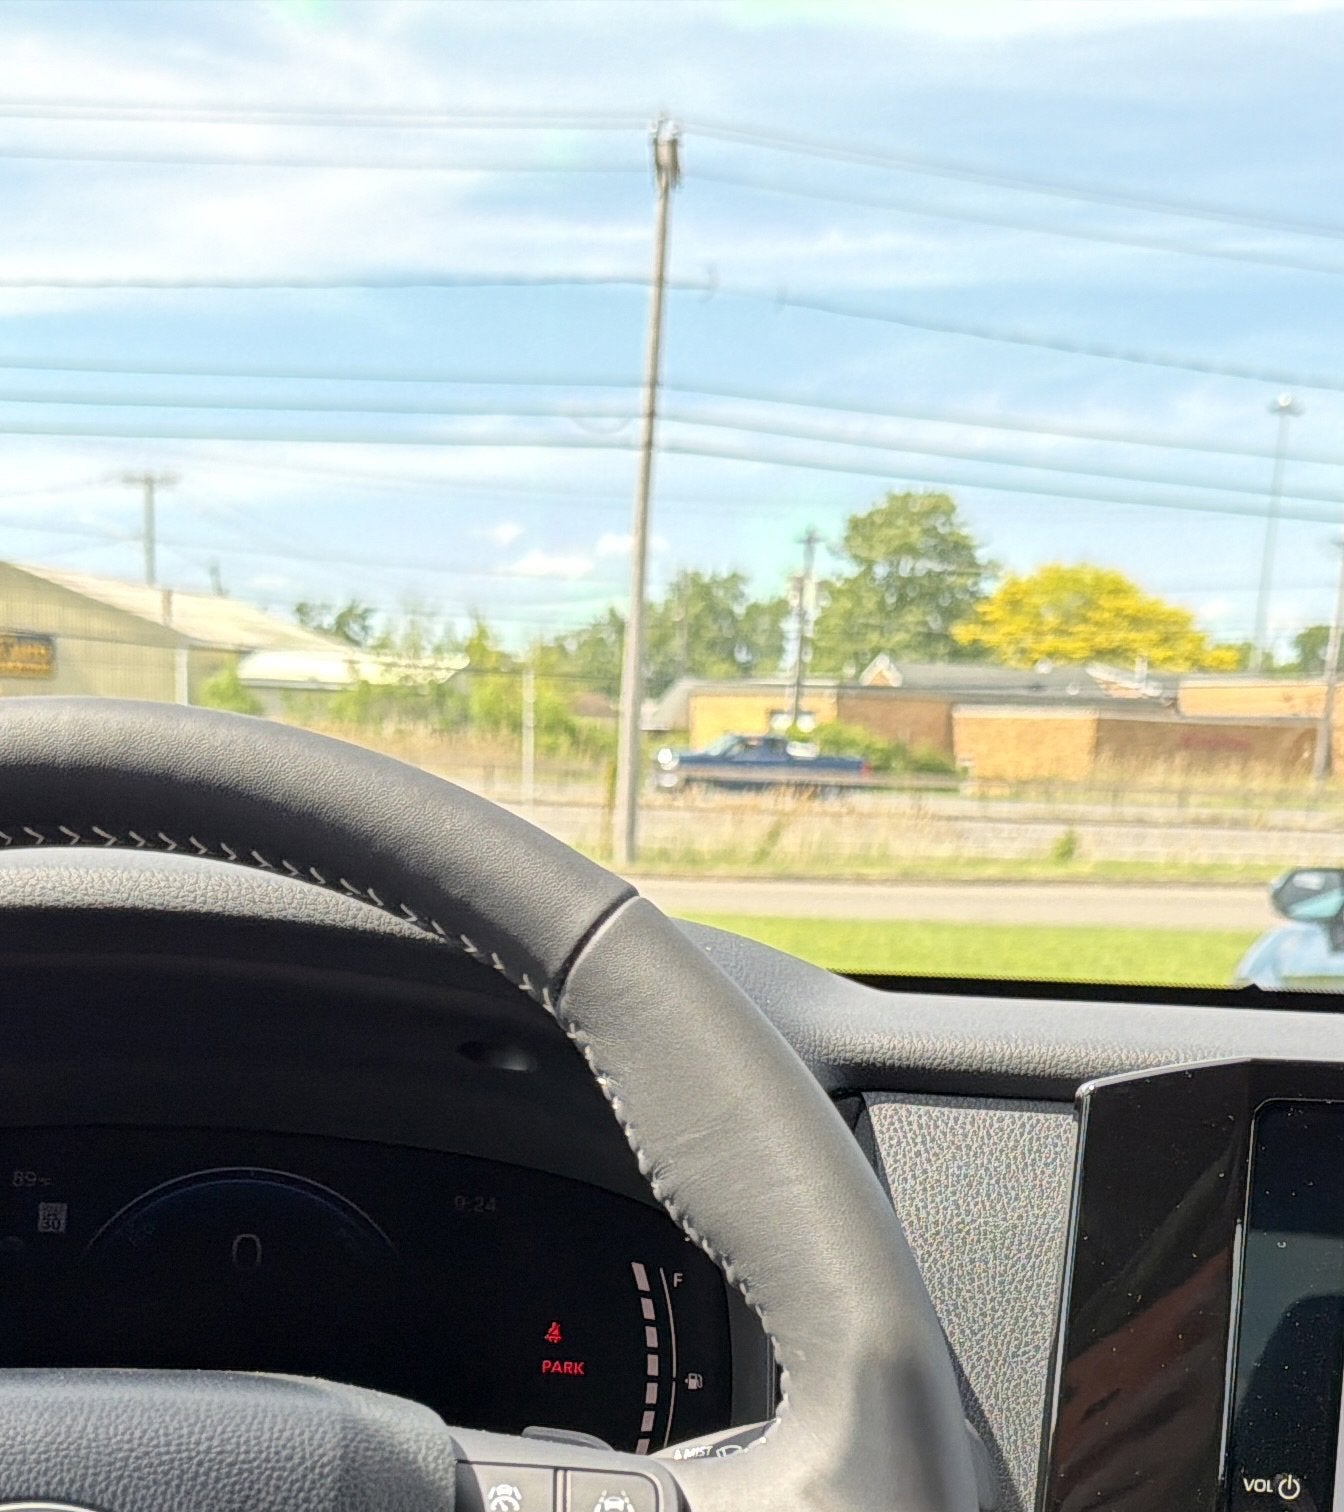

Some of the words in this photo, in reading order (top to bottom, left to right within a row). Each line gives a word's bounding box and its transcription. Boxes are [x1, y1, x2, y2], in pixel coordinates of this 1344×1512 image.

[672, 1272, 684, 1288] F
[541, 1359, 585, 1375] PARK
[1243, 1478, 1273, 1492] VOL
